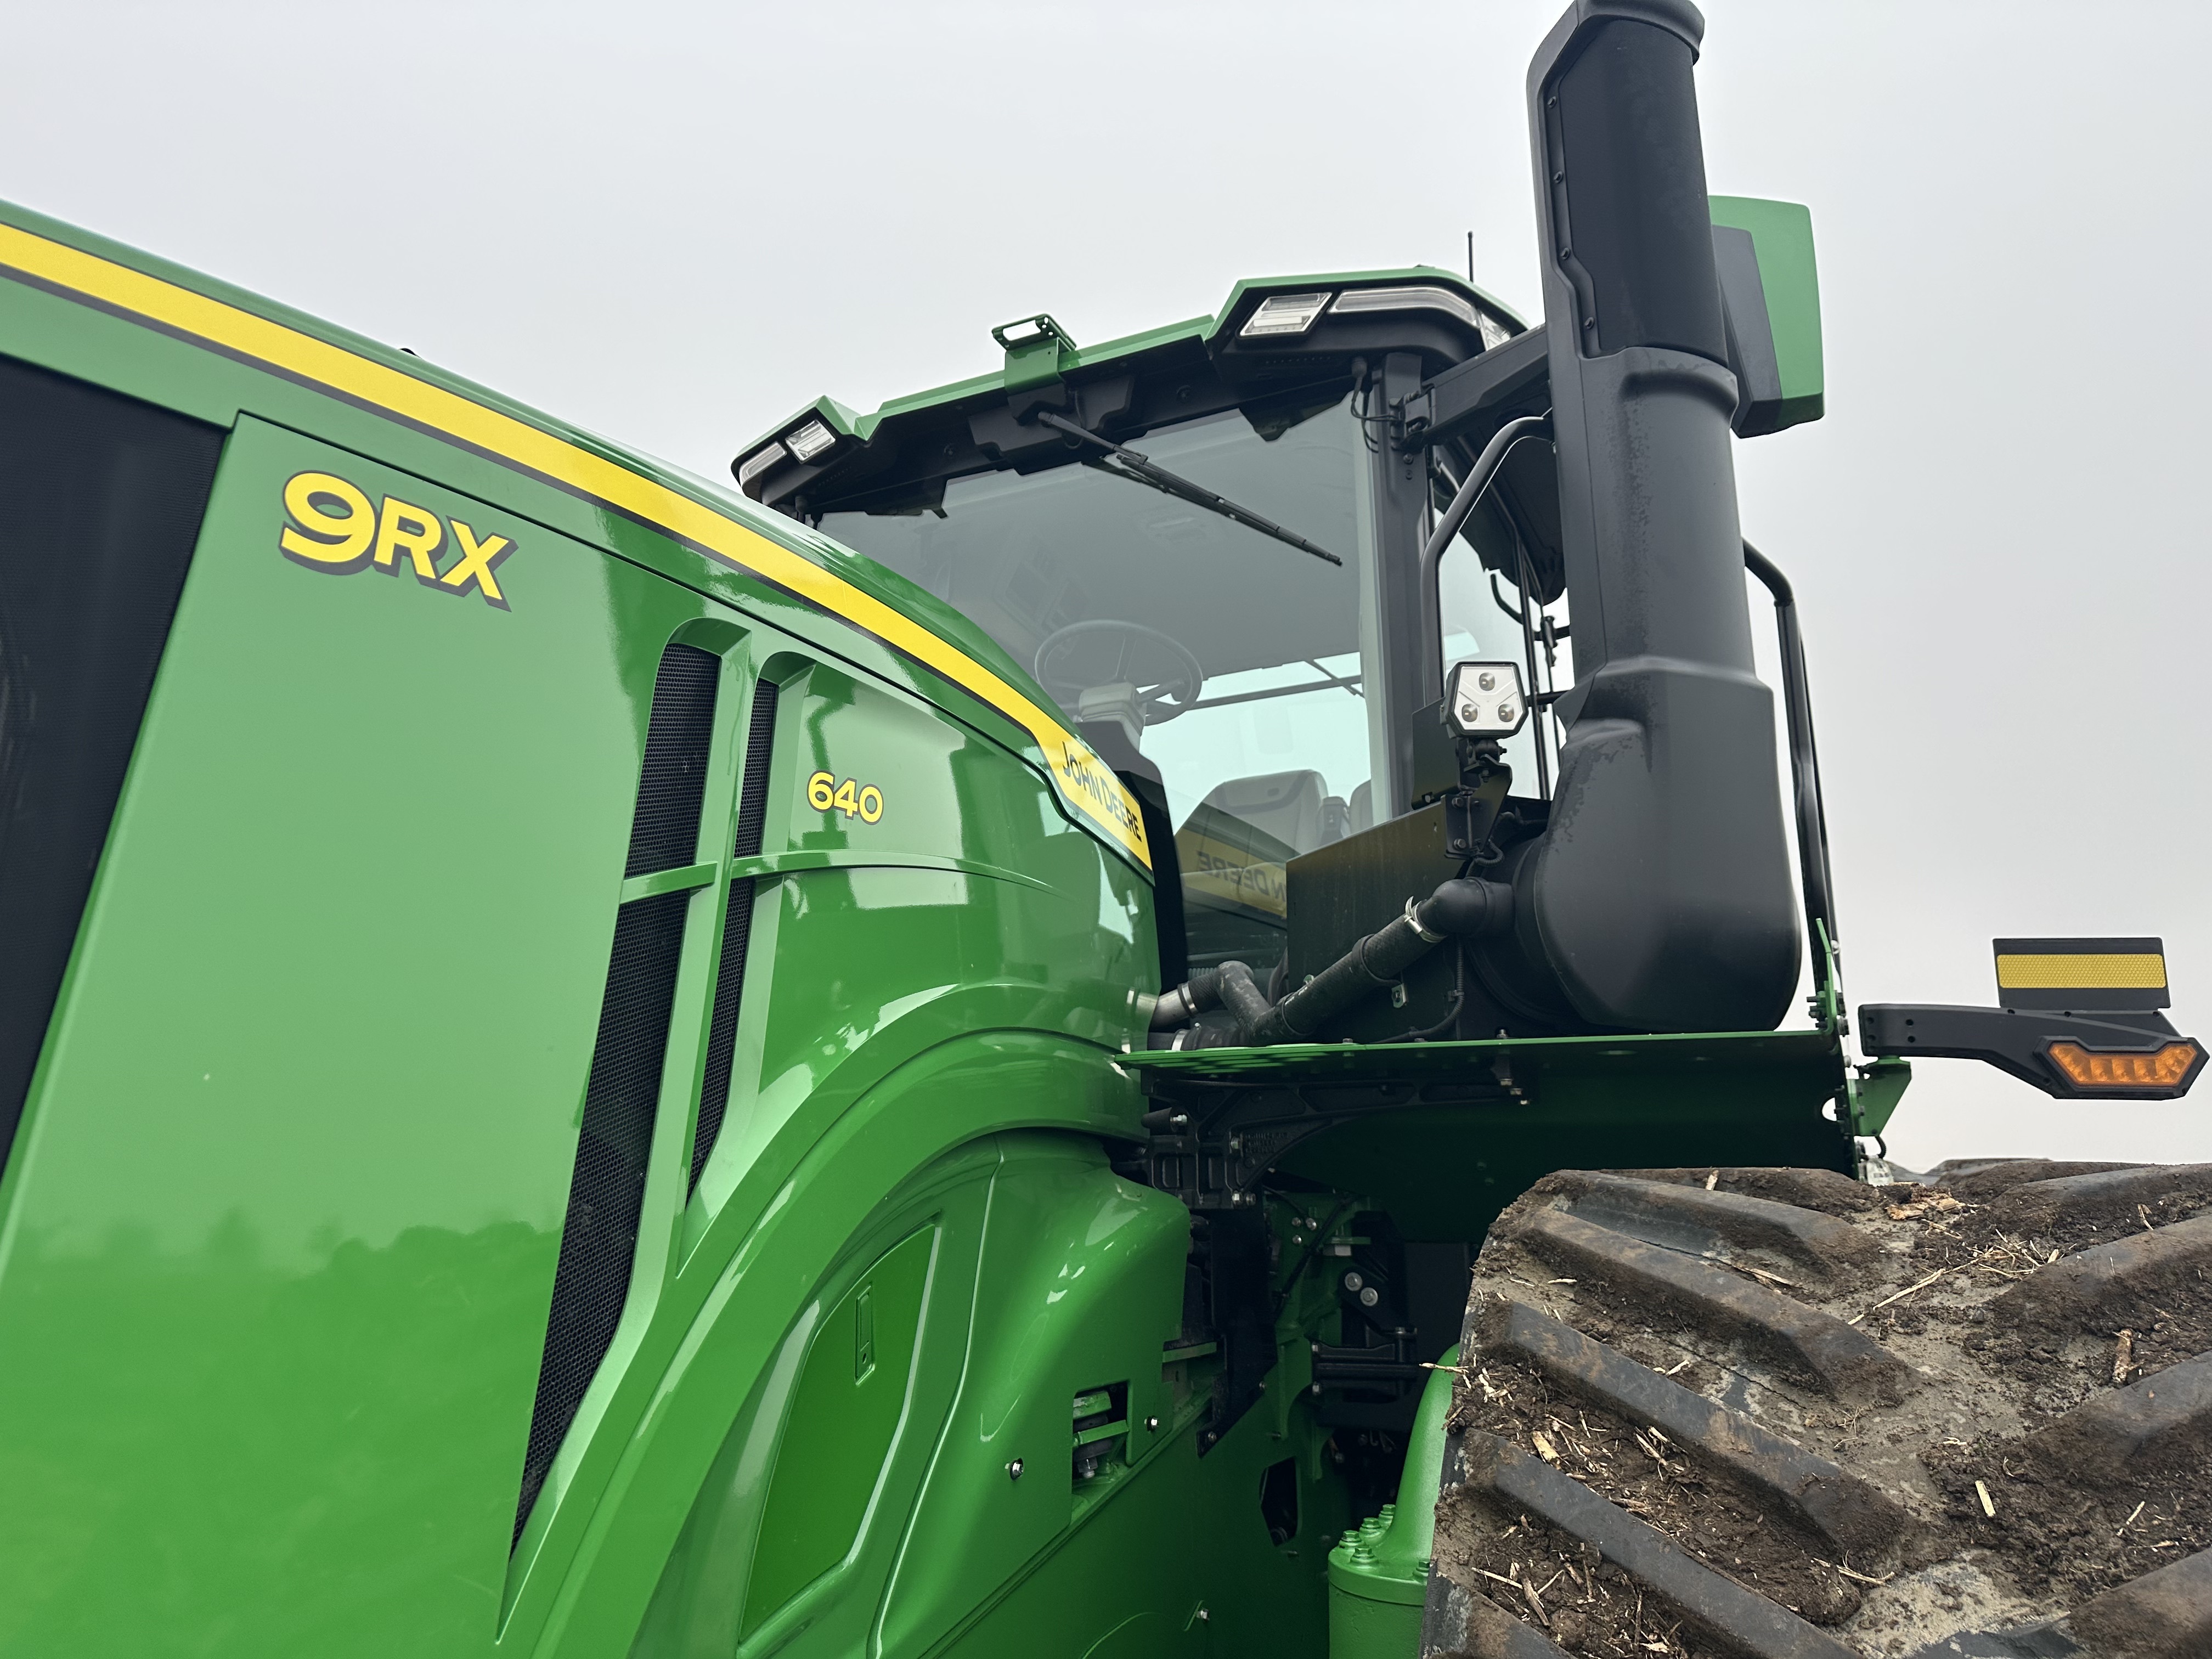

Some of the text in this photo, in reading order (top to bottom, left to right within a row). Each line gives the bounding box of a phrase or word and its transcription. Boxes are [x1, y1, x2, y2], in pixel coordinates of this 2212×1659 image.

[279, 471, 515, 607] 9RX
[808, 771, 884, 824] 640
[1062, 741, 1142, 843] JOHN DEERE
